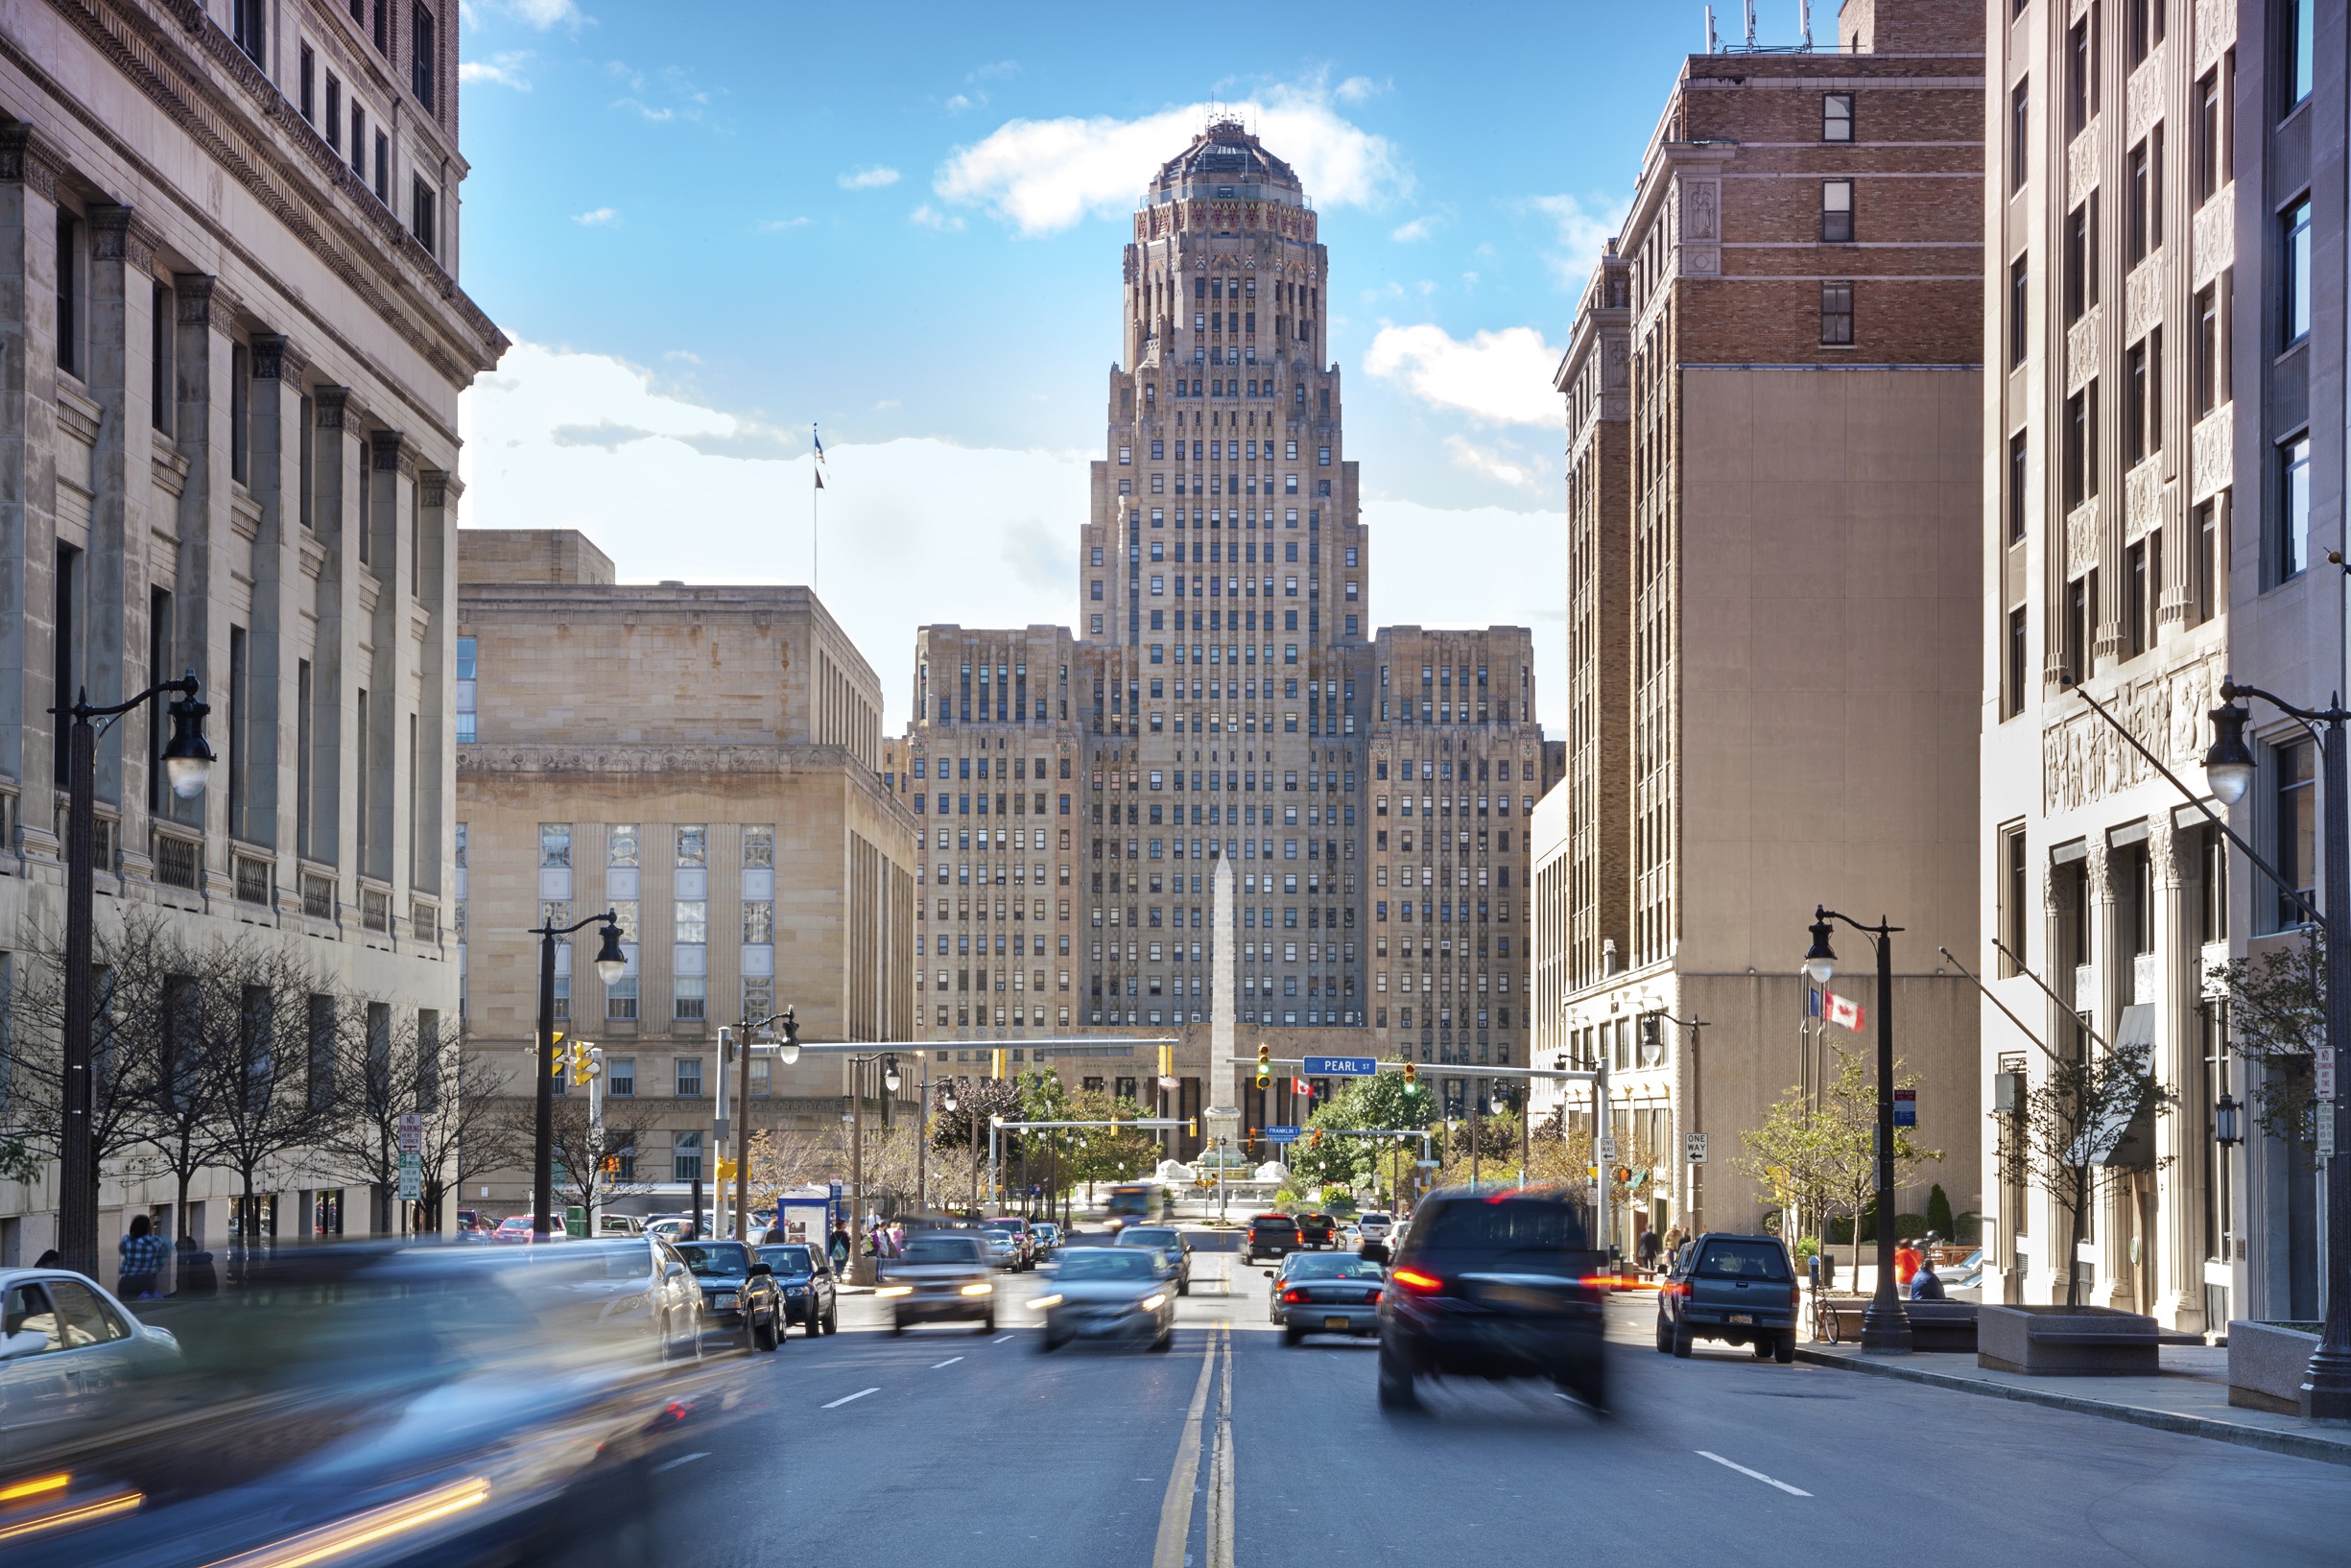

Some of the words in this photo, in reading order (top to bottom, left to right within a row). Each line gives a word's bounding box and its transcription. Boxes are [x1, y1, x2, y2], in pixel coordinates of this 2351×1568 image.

[2322, 1050, 2329, 1060] NO
[1324, 1060, 1358, 1072] PEARL
[400, 1155, 405, 1166] 2
